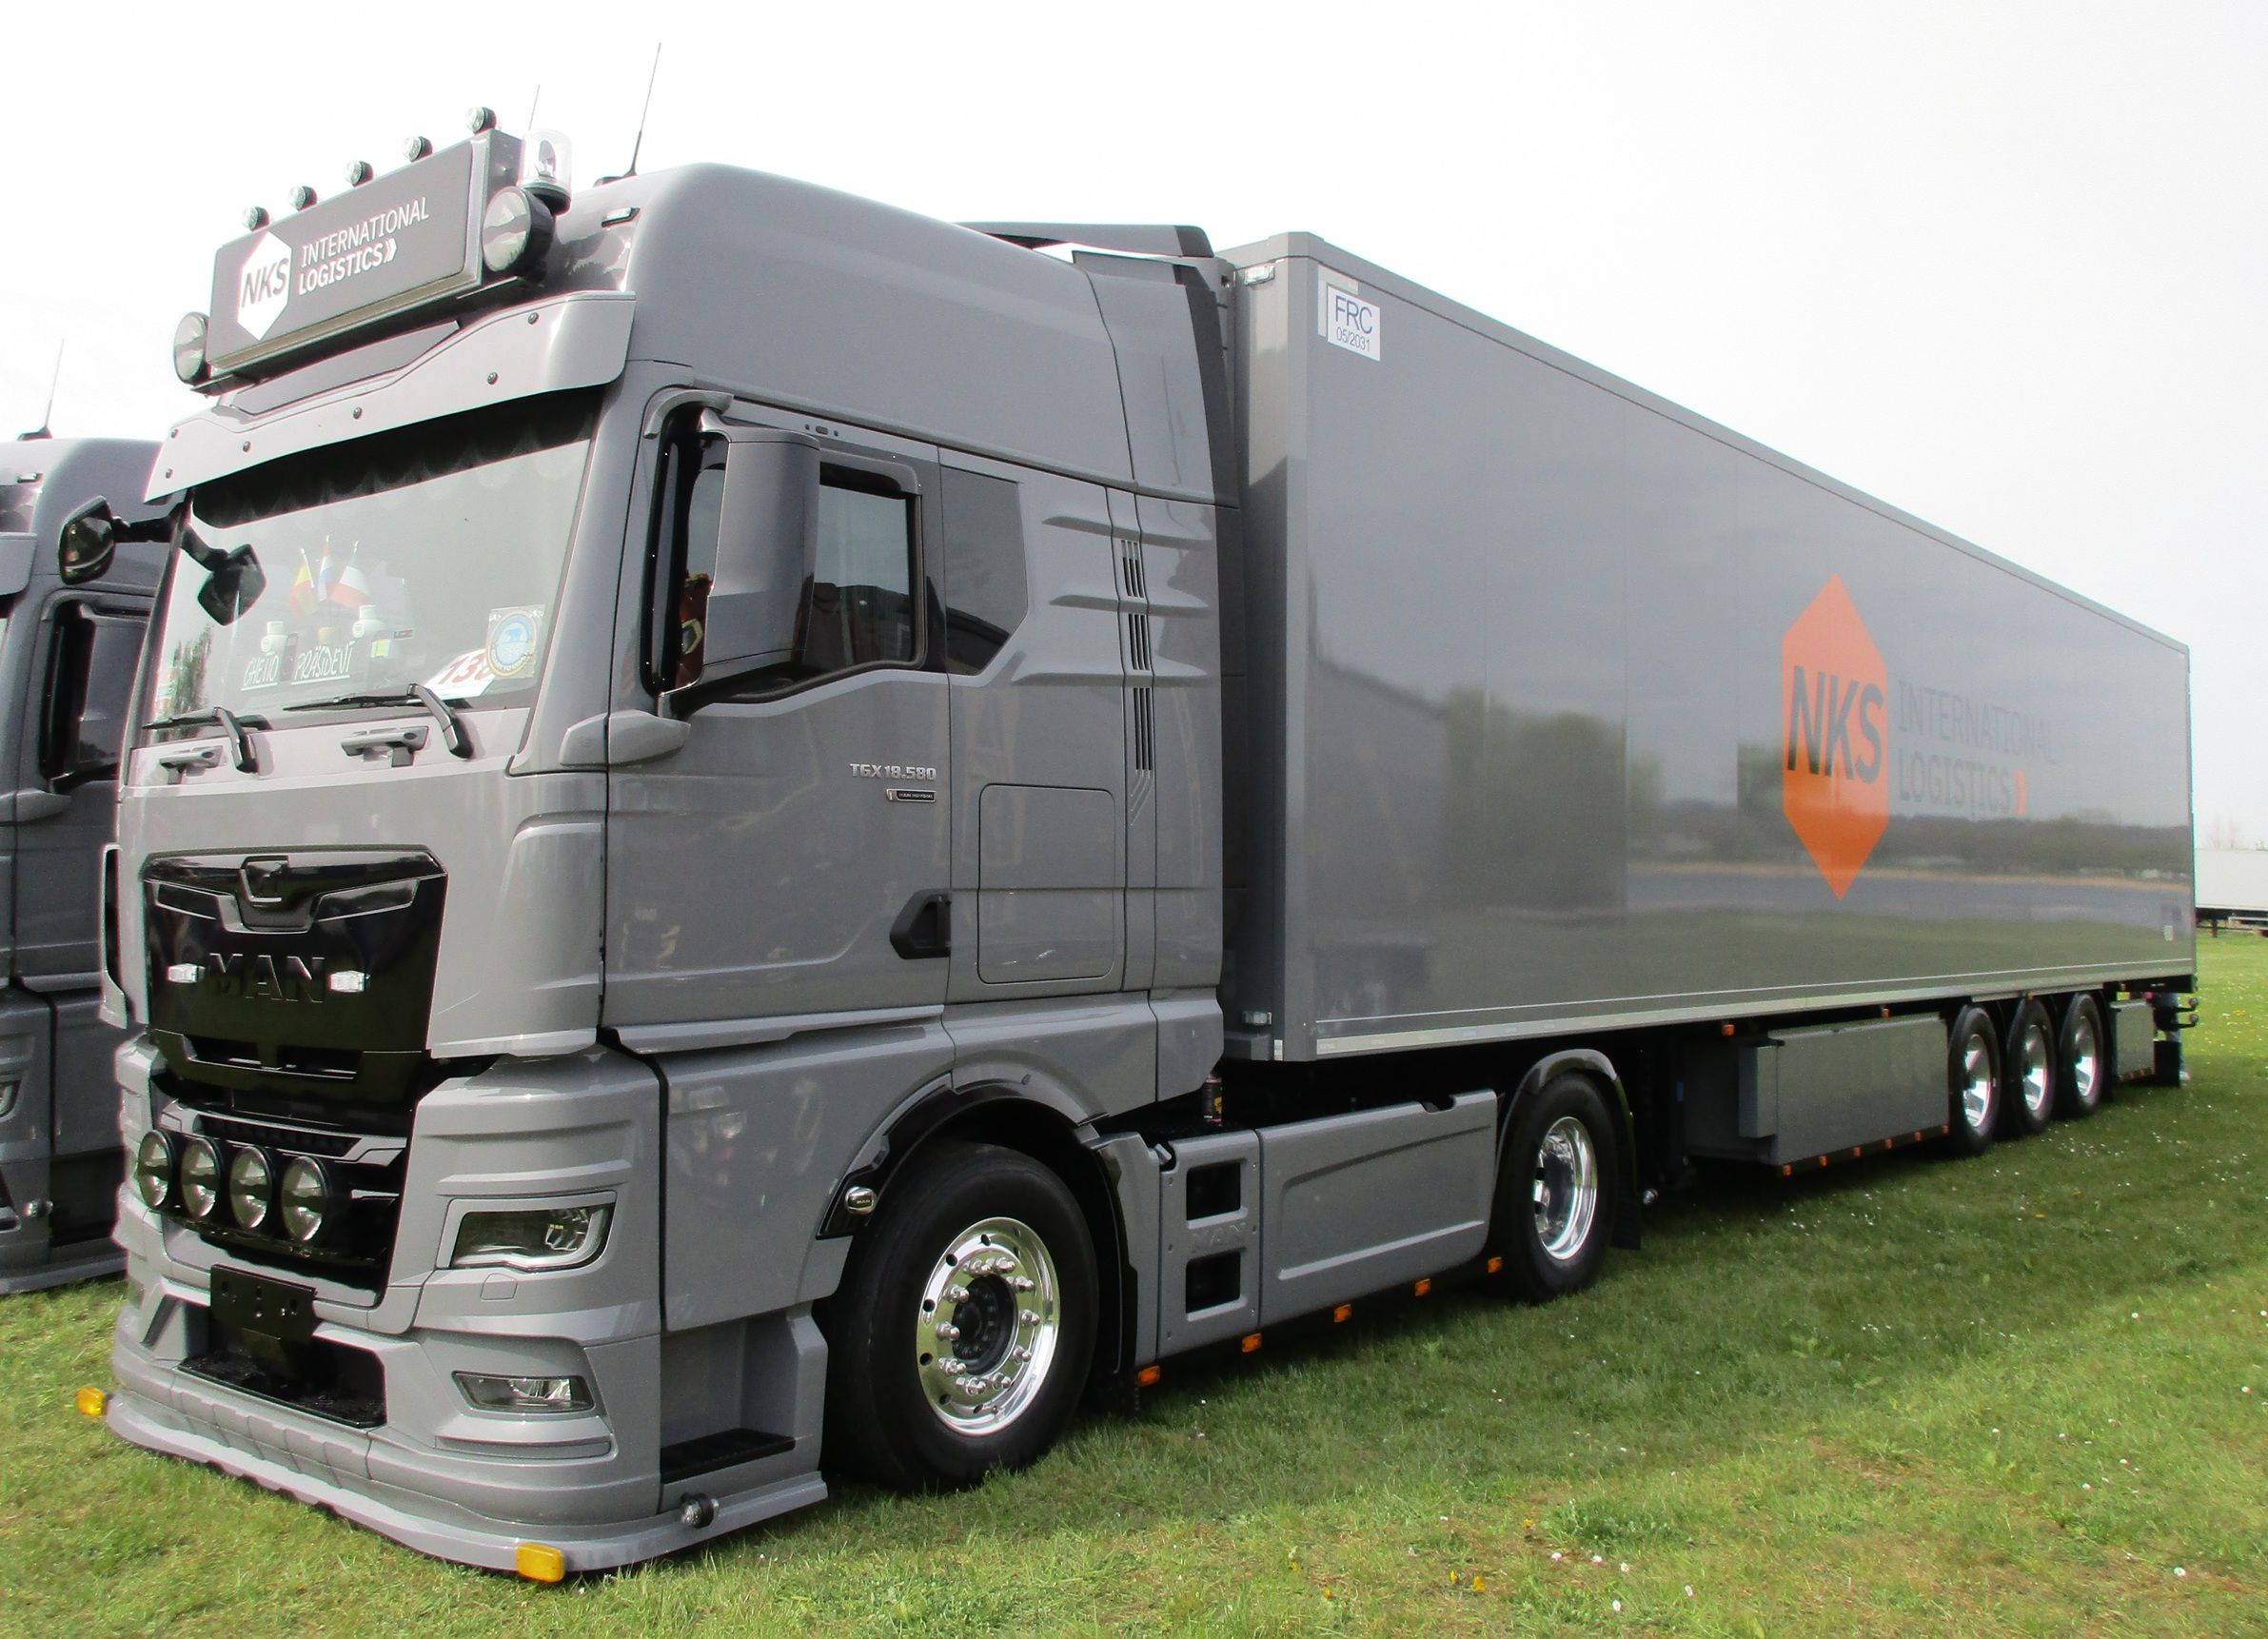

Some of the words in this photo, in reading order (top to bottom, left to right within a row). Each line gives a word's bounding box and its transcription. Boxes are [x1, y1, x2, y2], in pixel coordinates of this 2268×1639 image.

[300, 196, 430, 268] INTERNATIONAL
[241, 257, 289, 309] NKS
[298, 243, 385, 296] LOGISTICS
[1335, 294, 1372, 334] FRC
[1336, 326, 1371, 351] 05/2031
[1786, 665, 1884, 783] NKS
[1898, 679, 2057, 764] INTERNATIONAL
[850, 763, 882, 778] TGX
[884, 765, 937, 780] 18.580
[1898, 748, 2012, 814] LOGISTICS
[208, 953, 325, 1003] MAN
